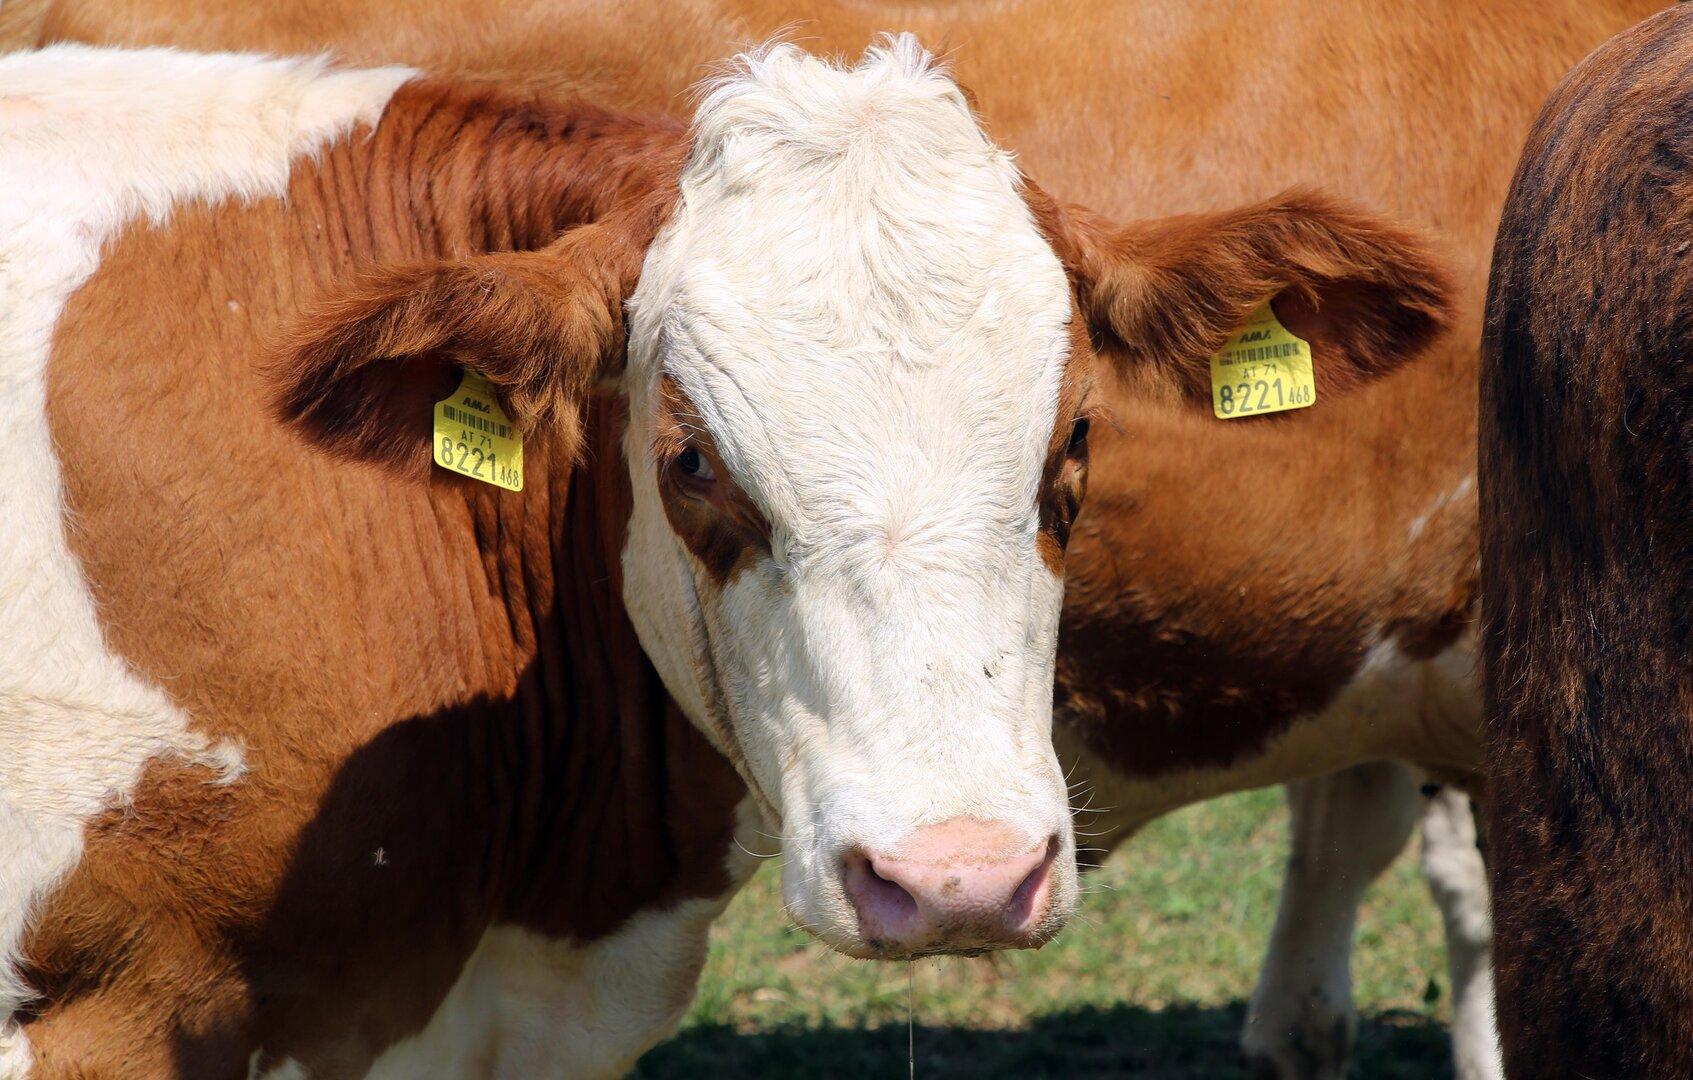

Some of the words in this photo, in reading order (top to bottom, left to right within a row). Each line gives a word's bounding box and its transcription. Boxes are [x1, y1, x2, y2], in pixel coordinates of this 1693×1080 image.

[1243, 366, 1256, 379] AT
[1263, 364, 1277, 375] 71
[1220, 378, 1284, 414] 8221
[1289, 385, 1310, 404] 468
[461, 430, 474, 442] AT
[480, 435, 492, 449] 71
[441, 437, 496, 481] 8221
[500, 466, 519, 487] 468
